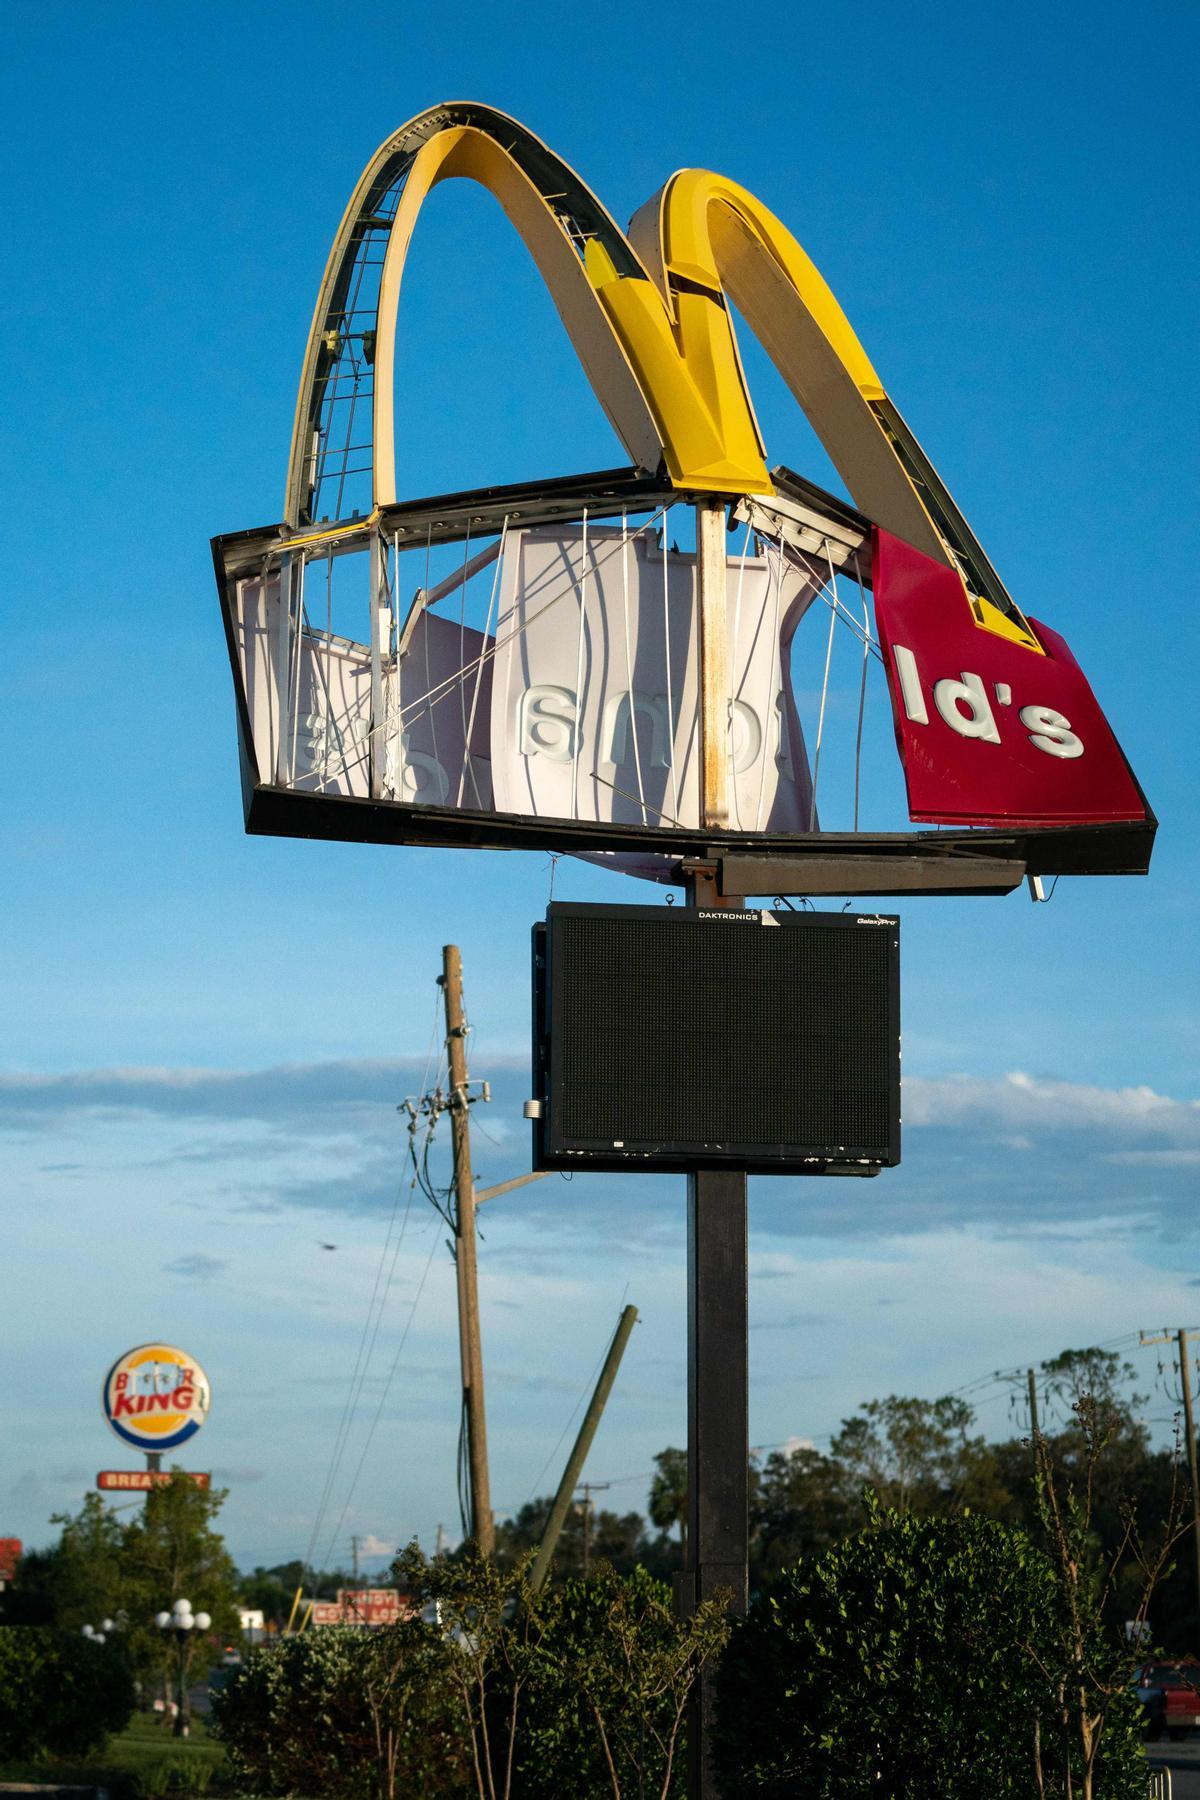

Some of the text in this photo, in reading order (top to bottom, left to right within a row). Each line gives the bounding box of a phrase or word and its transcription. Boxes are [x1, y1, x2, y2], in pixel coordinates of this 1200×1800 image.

[698, 911, 759, 921] DAKTRONICS
[856, 917, 897, 926] GalaxyPro
[113, 1386, 193, 1417] KING
